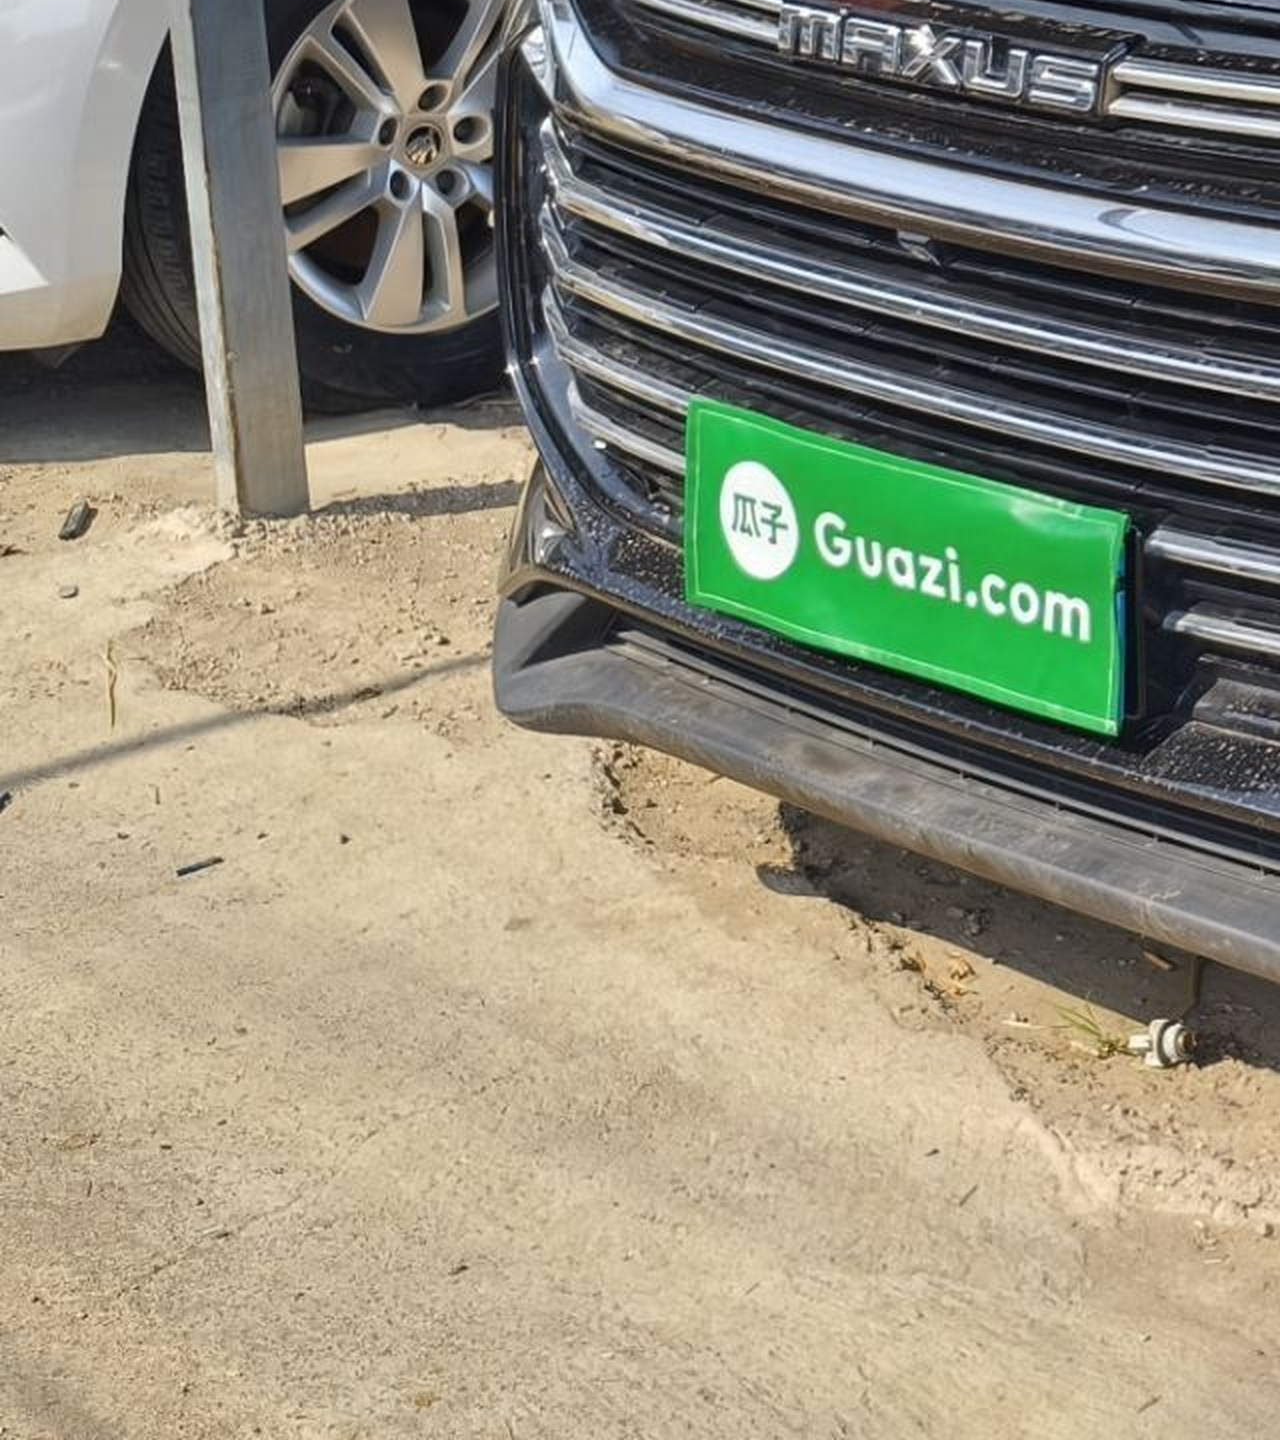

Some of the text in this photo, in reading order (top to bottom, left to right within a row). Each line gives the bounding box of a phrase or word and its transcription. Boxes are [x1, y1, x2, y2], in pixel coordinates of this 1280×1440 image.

[778, 4, 1100, 113] MAXUS
[731, 492, 789, 545] 瓜子
[813, 511, 1092, 643] Guazi.com
